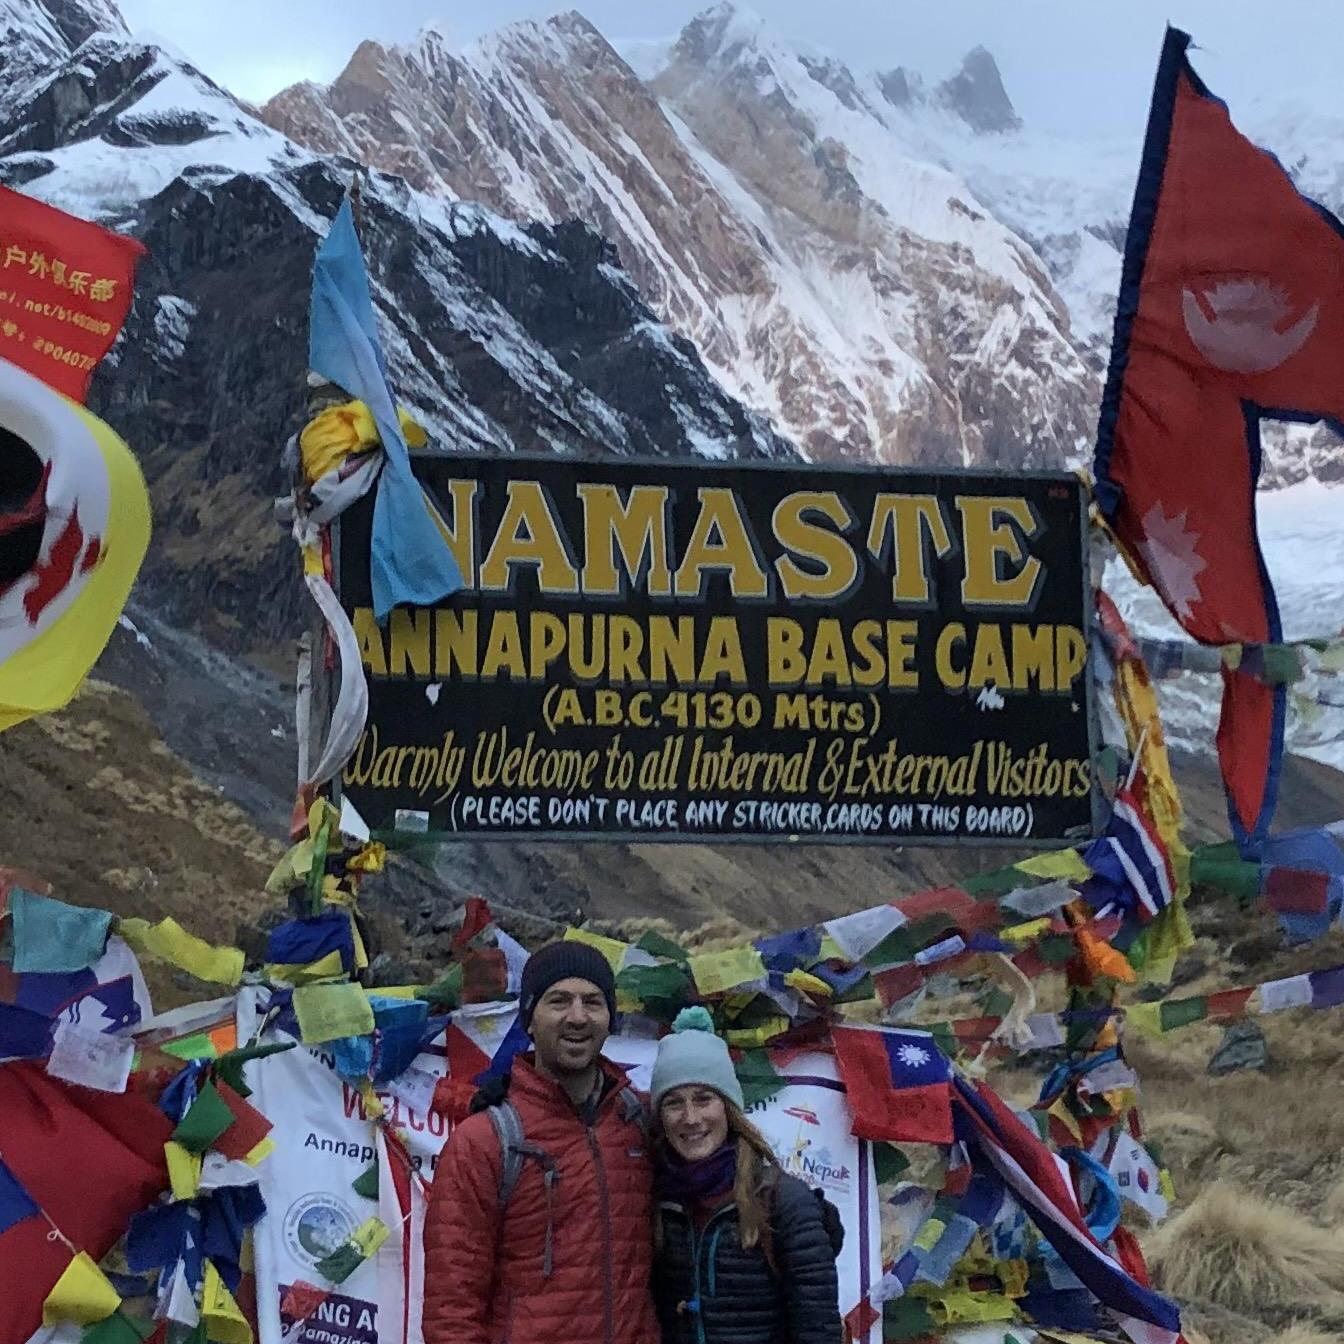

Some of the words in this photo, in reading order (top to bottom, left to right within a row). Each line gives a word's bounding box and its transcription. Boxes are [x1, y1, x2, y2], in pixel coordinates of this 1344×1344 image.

[350, 606, 748, 686] ANNAPURNA
[766, 616, 920, 690] BASE
[934, 621, 1088, 692] CAMP
[342, 723, 467, 804] Warmly
[471, 725, 600, 794] Welcome
[605, 733, 636, 791] to
[638, 733, 685, 791] all
[687, 734, 818, 794] Internal
[547, 793, 611, 826] DON'T
[615, 798, 680, 830] PLACE
[685, 799, 731, 829] ANY
[888, 804, 914, 832] ON
[916, 804, 960, 832] THIS
